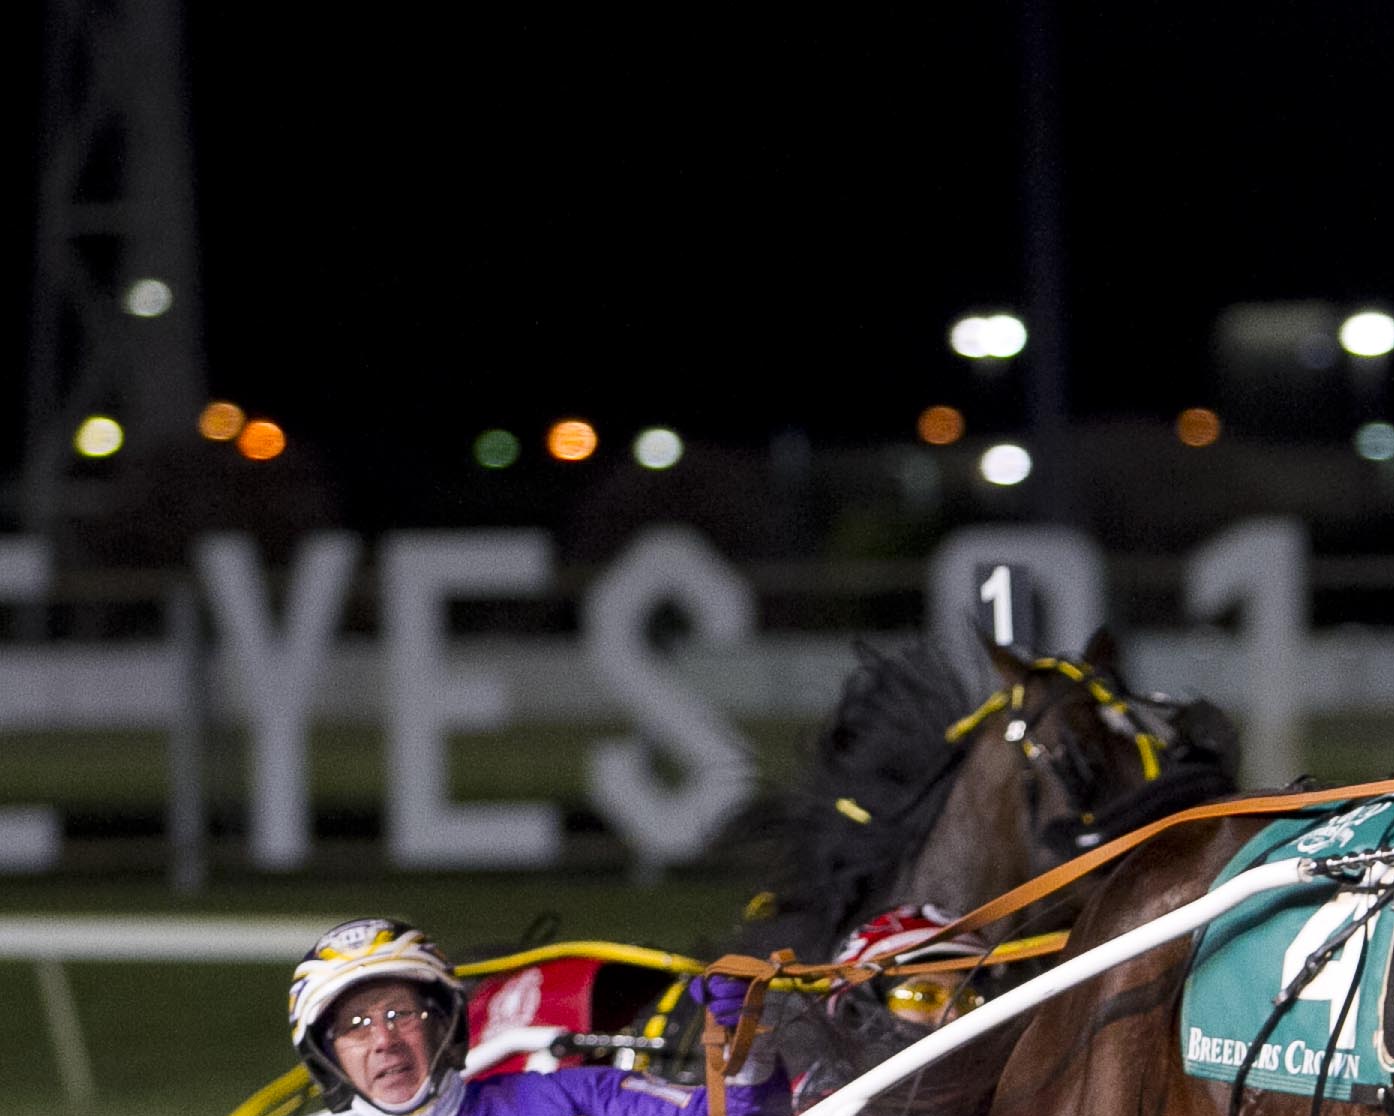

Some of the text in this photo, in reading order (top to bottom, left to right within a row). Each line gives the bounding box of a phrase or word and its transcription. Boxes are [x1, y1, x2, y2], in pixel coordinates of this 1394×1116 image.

[980, 565, 1014, 647] 1
[198, 526, 762, 872] YES
[1187, 1026, 1282, 1071] BREEDRS
